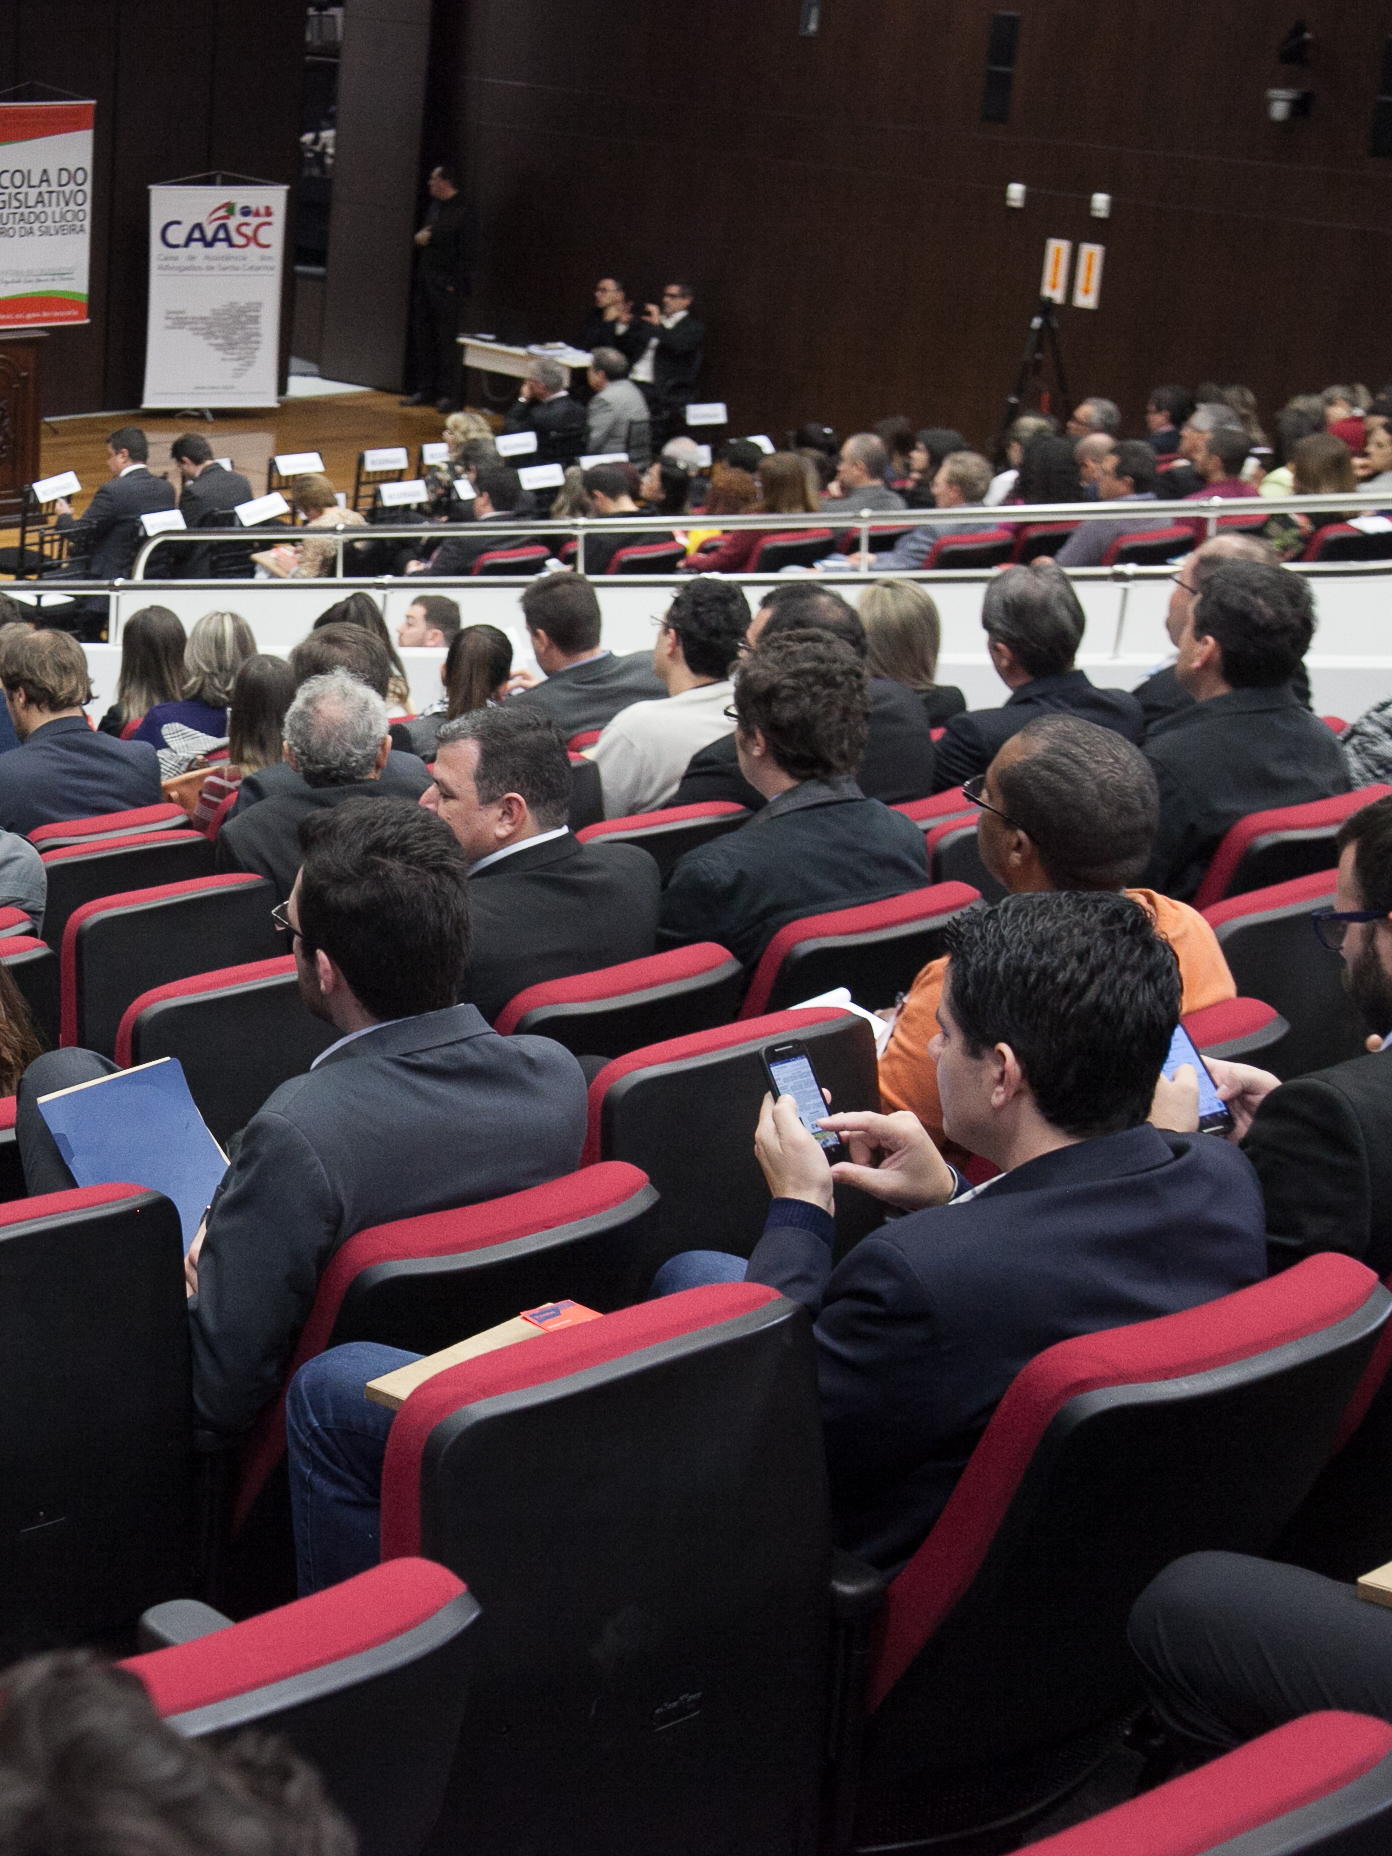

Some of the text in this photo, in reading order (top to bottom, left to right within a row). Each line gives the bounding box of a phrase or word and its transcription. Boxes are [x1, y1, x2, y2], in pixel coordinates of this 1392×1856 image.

[57, 166, 88, 188] DO
[51, 207, 87, 224] LÍCIO
[19, 225, 35, 238] DA
[37, 223, 86, 237] SILVEIRA
[160, 220, 273, 249] CAASC
